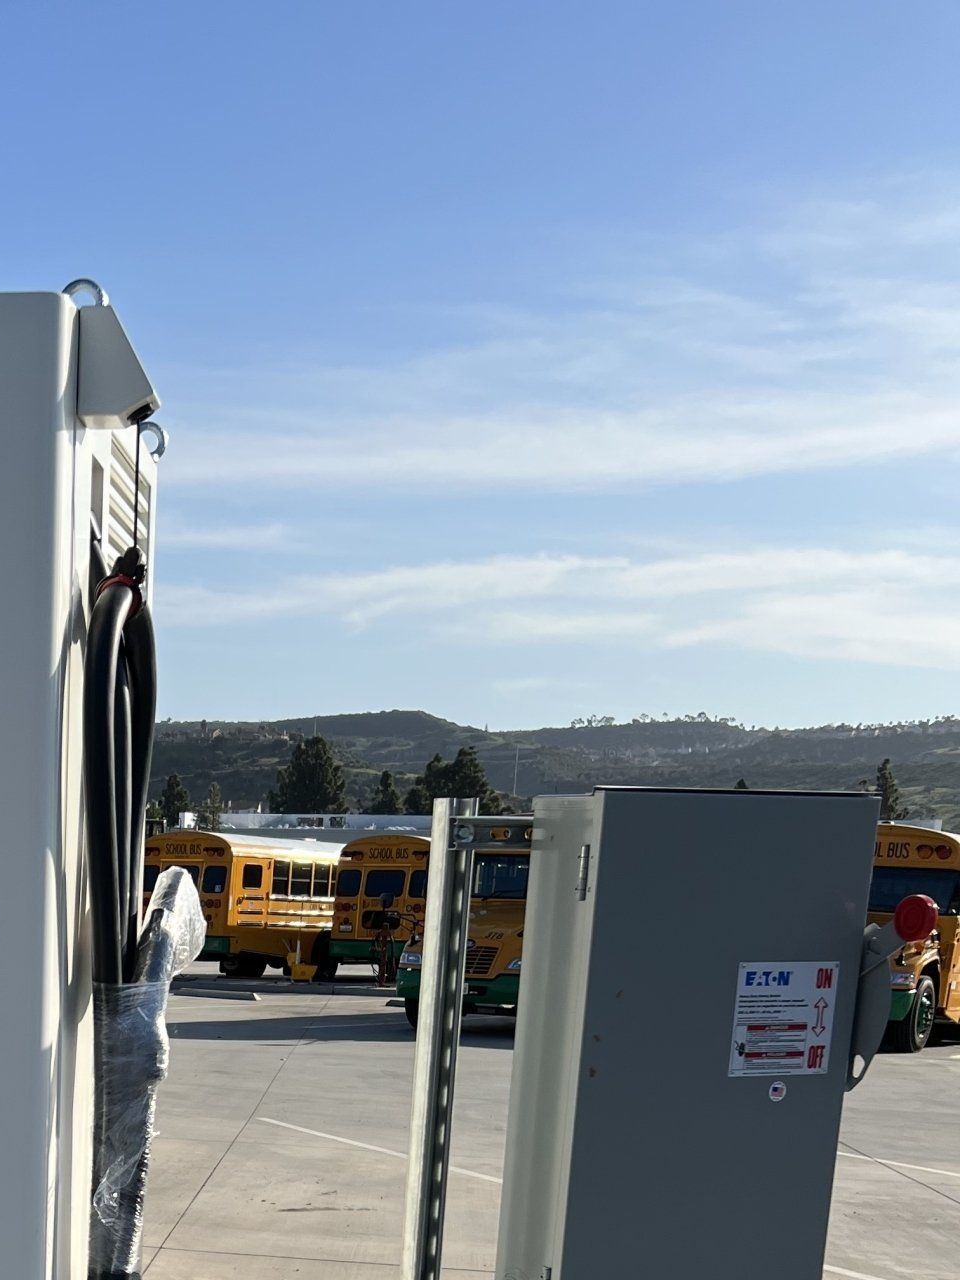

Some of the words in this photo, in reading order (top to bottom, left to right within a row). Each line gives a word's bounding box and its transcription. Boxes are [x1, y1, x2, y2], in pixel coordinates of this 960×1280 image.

[165, 843, 188, 856] SCHOOL
[189, 843, 202, 856] BUS
[368, 847, 394, 860] SCHOOL
[395, 847, 409, 860] BUS
[887, 841, 911, 859] BUS
[744, 970, 792, 987] EATON
[815, 967, 833, 989] ON
[806, 1045, 827, 1069] OFF
